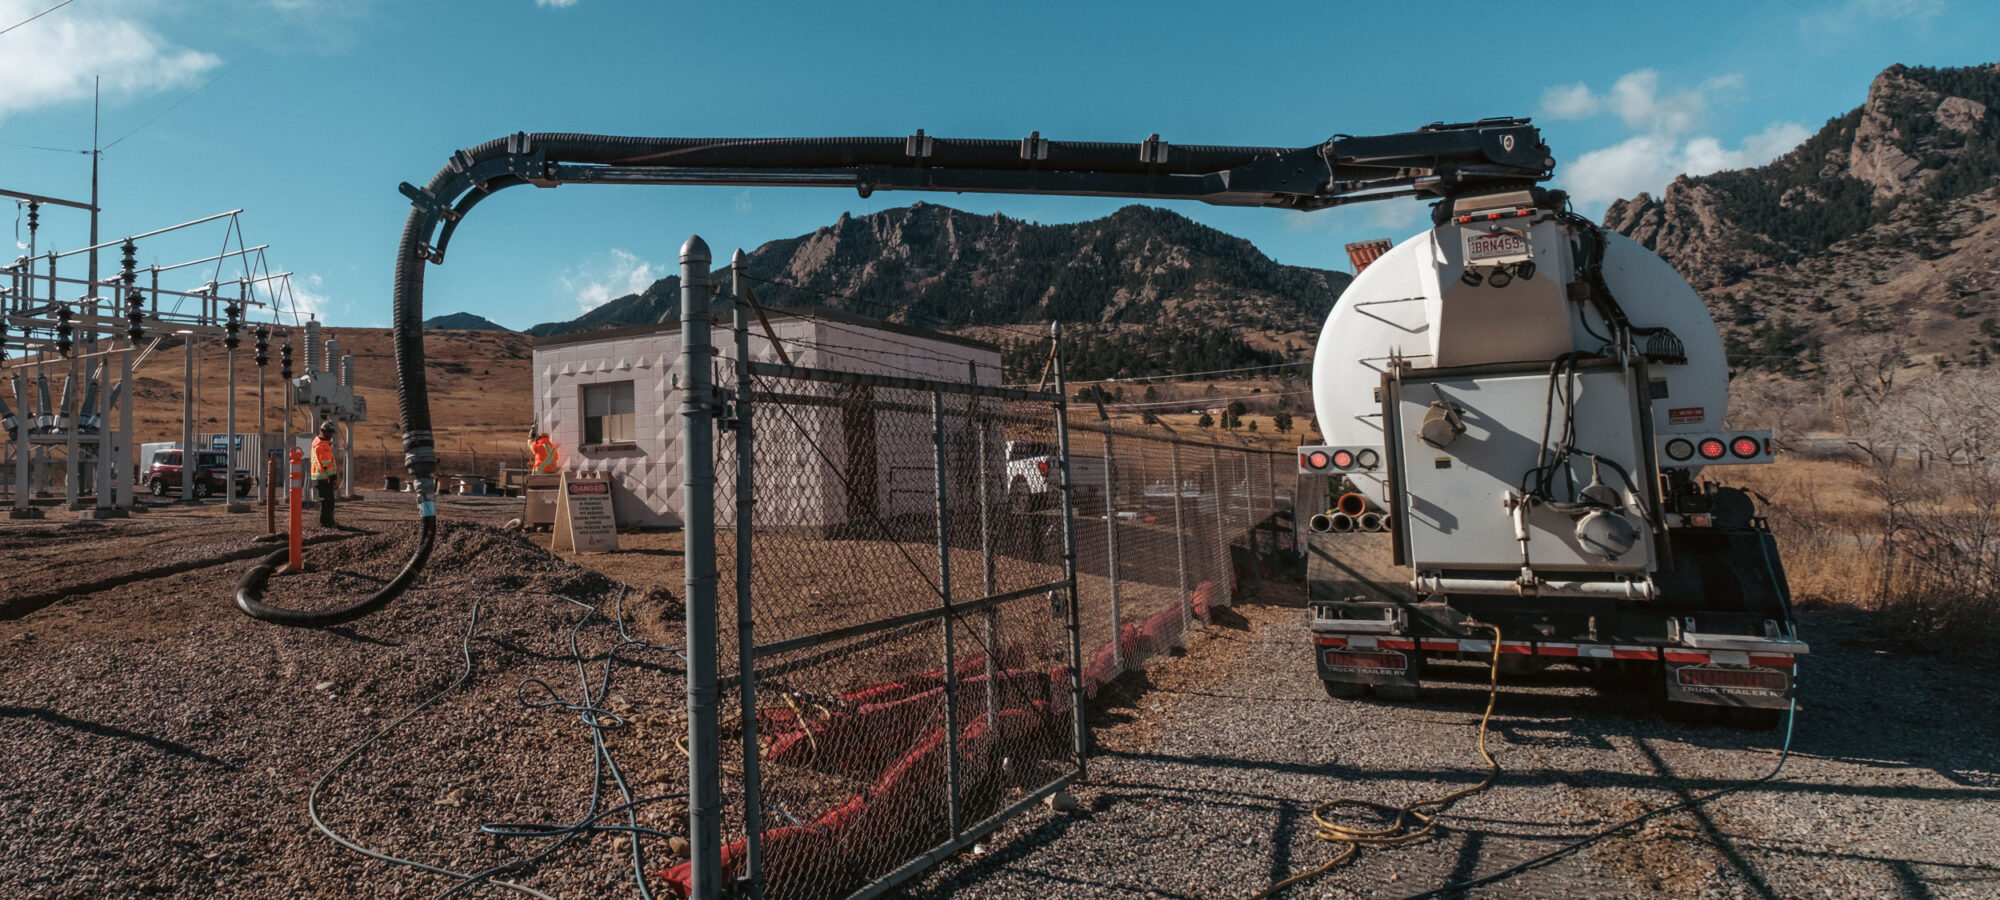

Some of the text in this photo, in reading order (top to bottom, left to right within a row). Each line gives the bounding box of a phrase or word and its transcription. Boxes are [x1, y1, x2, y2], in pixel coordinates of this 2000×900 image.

[1475, 237, 1520, 253] BRN459
[1358, 668, 1392, 676] TRAILER
[1682, 686, 1718, 694] TRUCK
[1721, 688, 1767, 697] TRAILER
